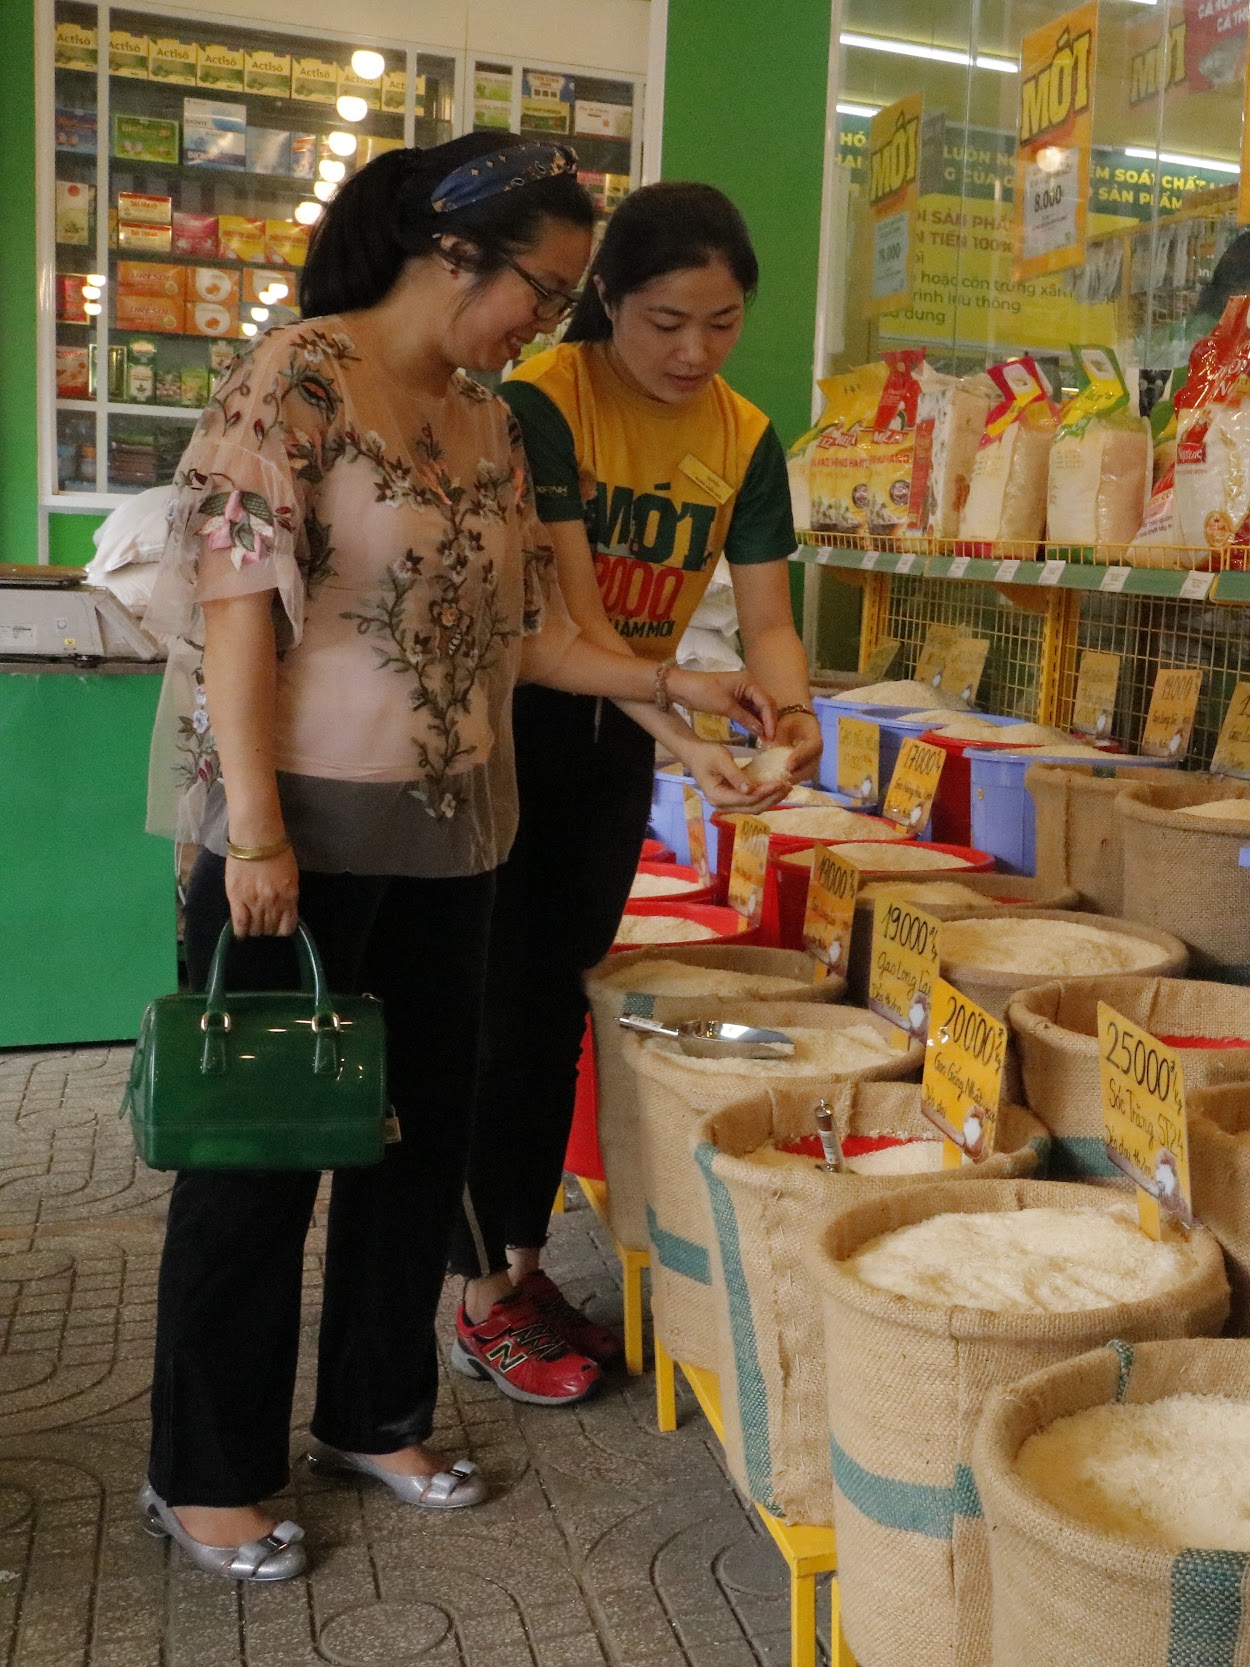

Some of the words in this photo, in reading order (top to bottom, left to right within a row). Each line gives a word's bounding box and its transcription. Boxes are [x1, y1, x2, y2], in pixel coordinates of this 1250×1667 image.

[389, 80, 406, 90] Act
[1020, 24, 1092, 148] MỚI
[870, 109, 919, 203] MỚI
[1097, 183, 1134, 204] SẢN
[585, 481, 718, 572] MỚI
[881, 902, 928, 955] 19000
[1105, 1021, 1170, 1101] 25000
[1109, 1078, 1126, 1115] Sóc
[1126, 1088, 1155, 1151] Trăng
[1157, 1113, 1184, 1163] ST24
[486, 1340, 528, 1374] N
